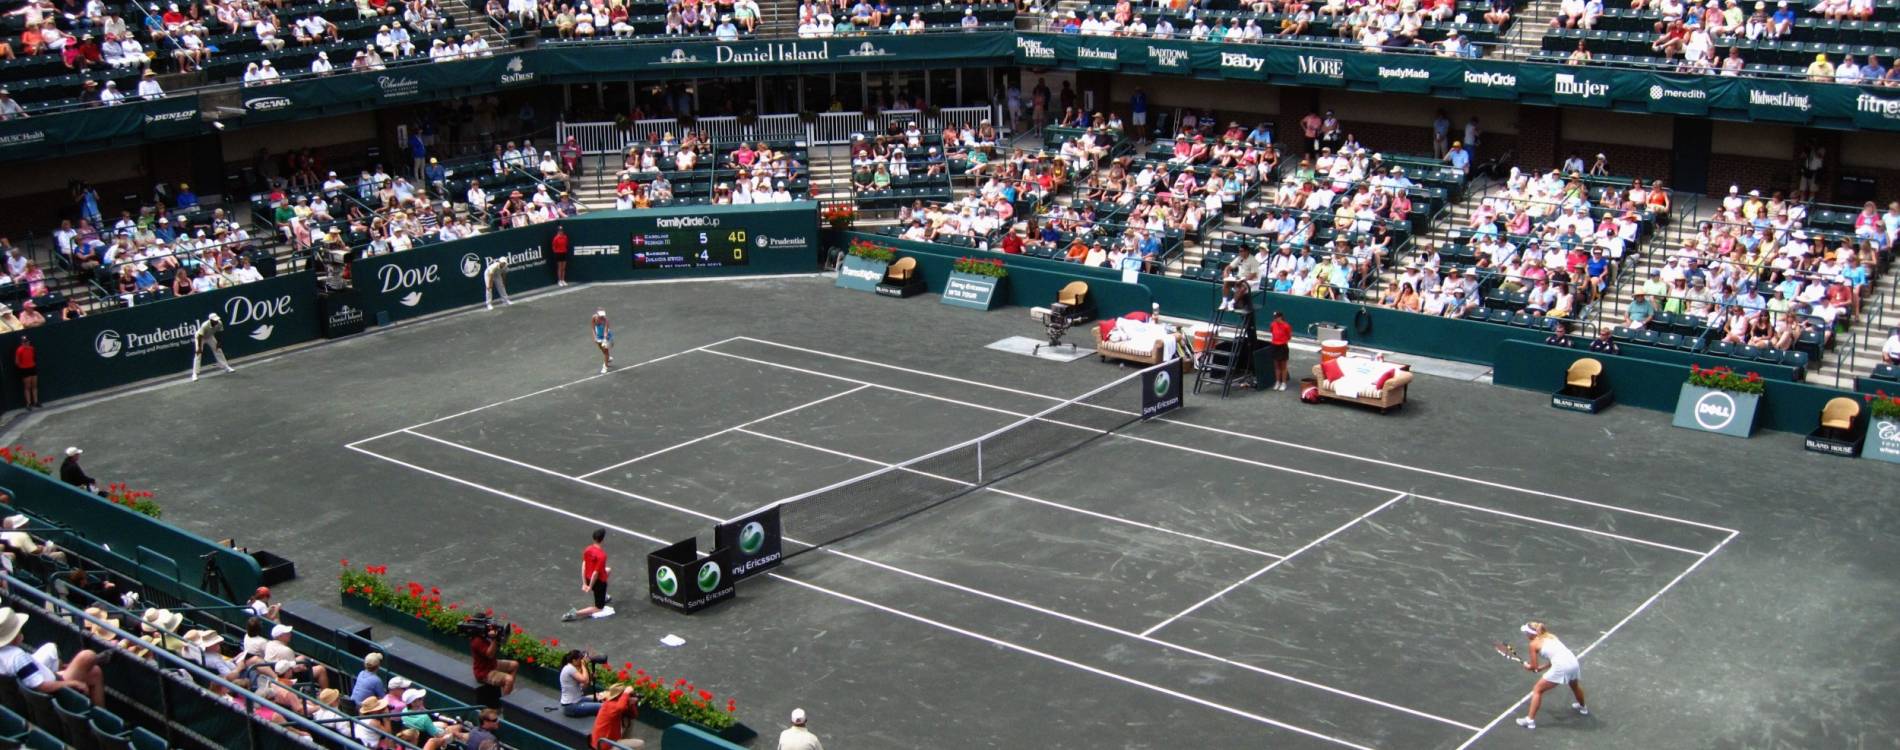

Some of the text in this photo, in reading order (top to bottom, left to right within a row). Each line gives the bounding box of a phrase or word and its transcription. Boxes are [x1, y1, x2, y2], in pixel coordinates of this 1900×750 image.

[1017, 36, 1042, 48] Better
[716, 41, 829, 64] Daniel Island
[1025, 47, 1055, 58] Homes
[1148, 46, 1188, 60] TRADITIONAL
[1158, 57, 1178, 67] HOME
[1220, 52, 1265, 72] baby
[1298, 55, 1344, 76] MORE
[1378, 66, 1430, 79] ReadyMade
[1464, 70, 1517, 87] FamilyCircle
[1555, 75, 1610, 98] mujer
[1664, 89, 1706, 99] meredith
[1749, 89, 1809, 112] Midwest Living
[153, 110, 198, 122] DUNLOP
[699, 232, 708, 244] 5
[728, 231, 746, 243] 40
[770, 237, 806, 245] Prudential
[484, 245, 543, 267] Prdential
[573, 245, 620, 256] ESPN2
[700, 249, 709, 261] 4
[733, 248, 743, 260] 0
[378, 263, 439, 293] Dove
[224, 295, 292, 326] Dove
[127, 319, 202, 349] Prudential
[1143, 405, 1157, 415] Sony
[1553, 398, 1573, 408] ISLAND
[1699, 402, 1730, 418] DELL
[1806, 439, 1854, 454] ISLAND HOUSE
[732, 551, 781, 576] ny Ericsson
[688, 586, 734, 609] Sony Ericsson
